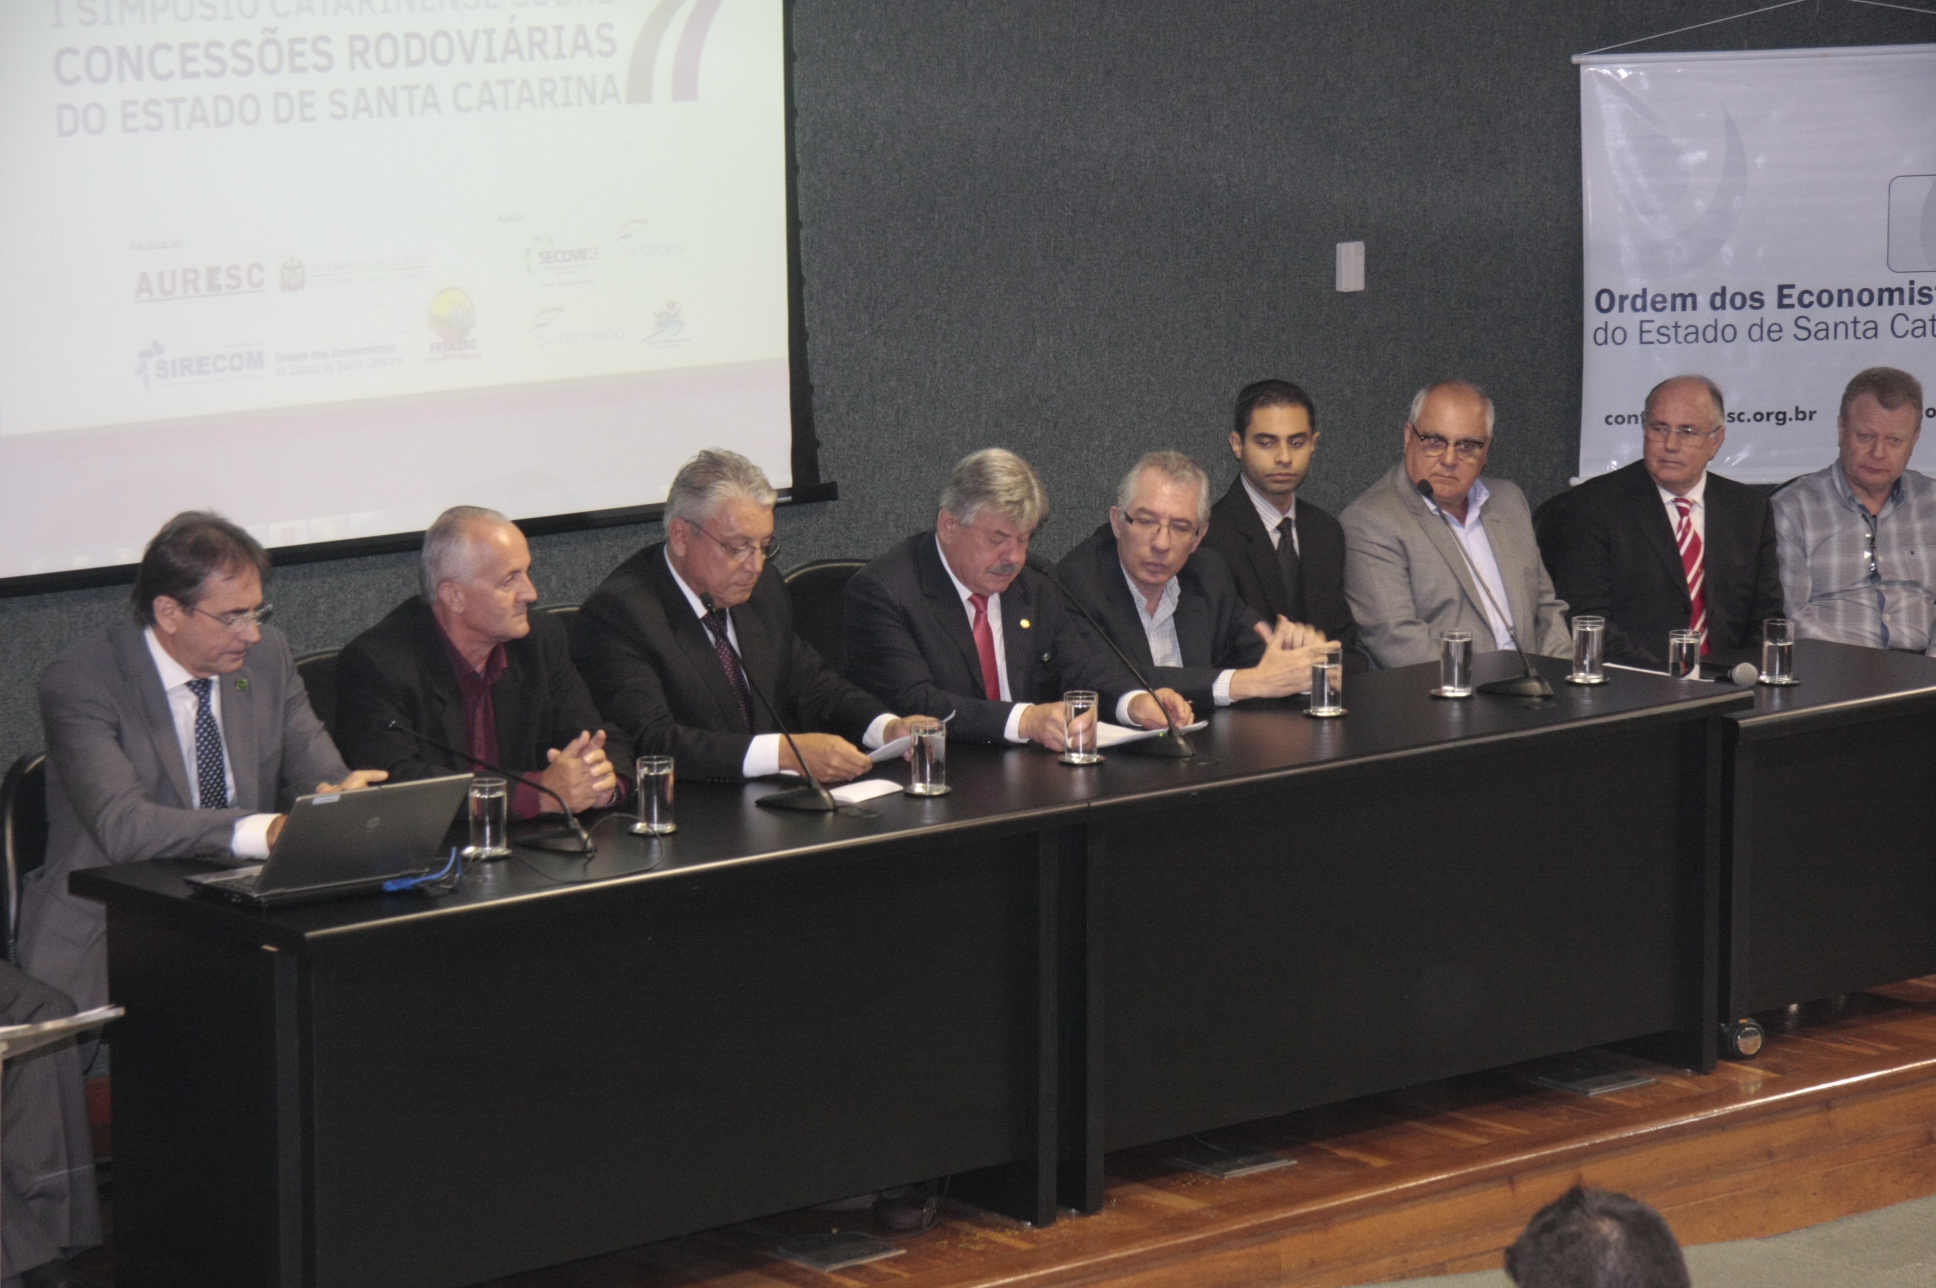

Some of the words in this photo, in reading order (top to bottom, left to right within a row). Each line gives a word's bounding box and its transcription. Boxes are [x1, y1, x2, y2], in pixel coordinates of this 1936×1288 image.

[53, 26, 334, 87] CONCESSÕES
[348, 14, 618, 71] RODOVIÁRIAS
[55, 101, 107, 138] DO
[120, 93, 262, 134] ESTADO
[272, 89, 317, 125] DE
[327, 83, 442, 121] SANTA
[452, 73, 622, 113] CATARINA
[135, 262, 265, 299] AURESC
[1594, 287, 1698, 314] Ordem
[1708, 285, 1766, 311] dos
[1776, 280, 1936, 310] Economis
[1593, 320, 1628, 346] do
[1638, 318, 1738, 345] Estado
[1747, 316, 1784, 343] de
[1792, 315, 1880, 342] Santa
[155, 350, 265, 379] SIRECOM
